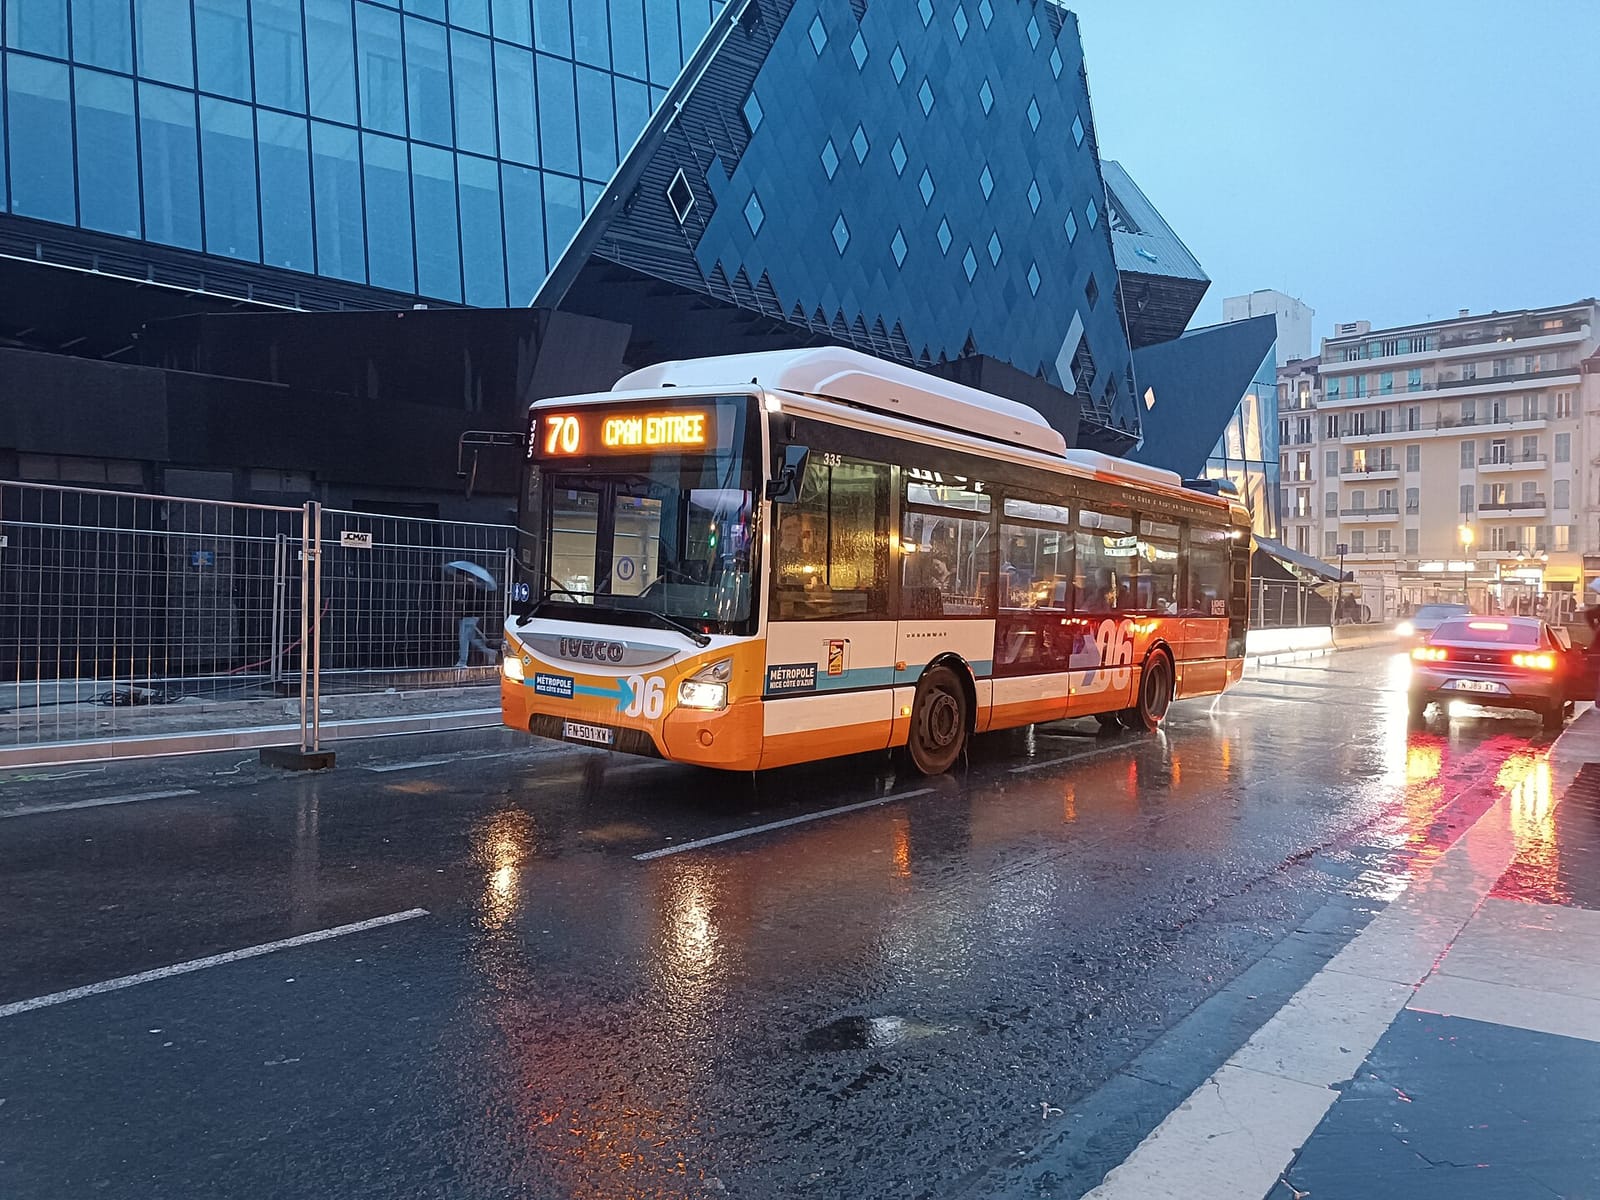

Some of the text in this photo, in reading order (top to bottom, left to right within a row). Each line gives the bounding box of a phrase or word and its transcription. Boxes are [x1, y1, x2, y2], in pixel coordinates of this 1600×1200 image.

[527, 419, 537, 458] 335
[547, 414, 705, 453] 70 CPAM ENTREE
[823, 452, 841, 467] 335
[344, 533, 368, 542] JCMAT
[560, 637, 624, 663] IVECO
[1097, 618, 1134, 691] 06
[536, 674, 572, 688] MÉTROPOLE
[770, 666, 815, 681] MÉTROPOLE
[770, 678, 814, 689] NICE CÔTE D'AZUR
[625, 675, 666, 719] 06
